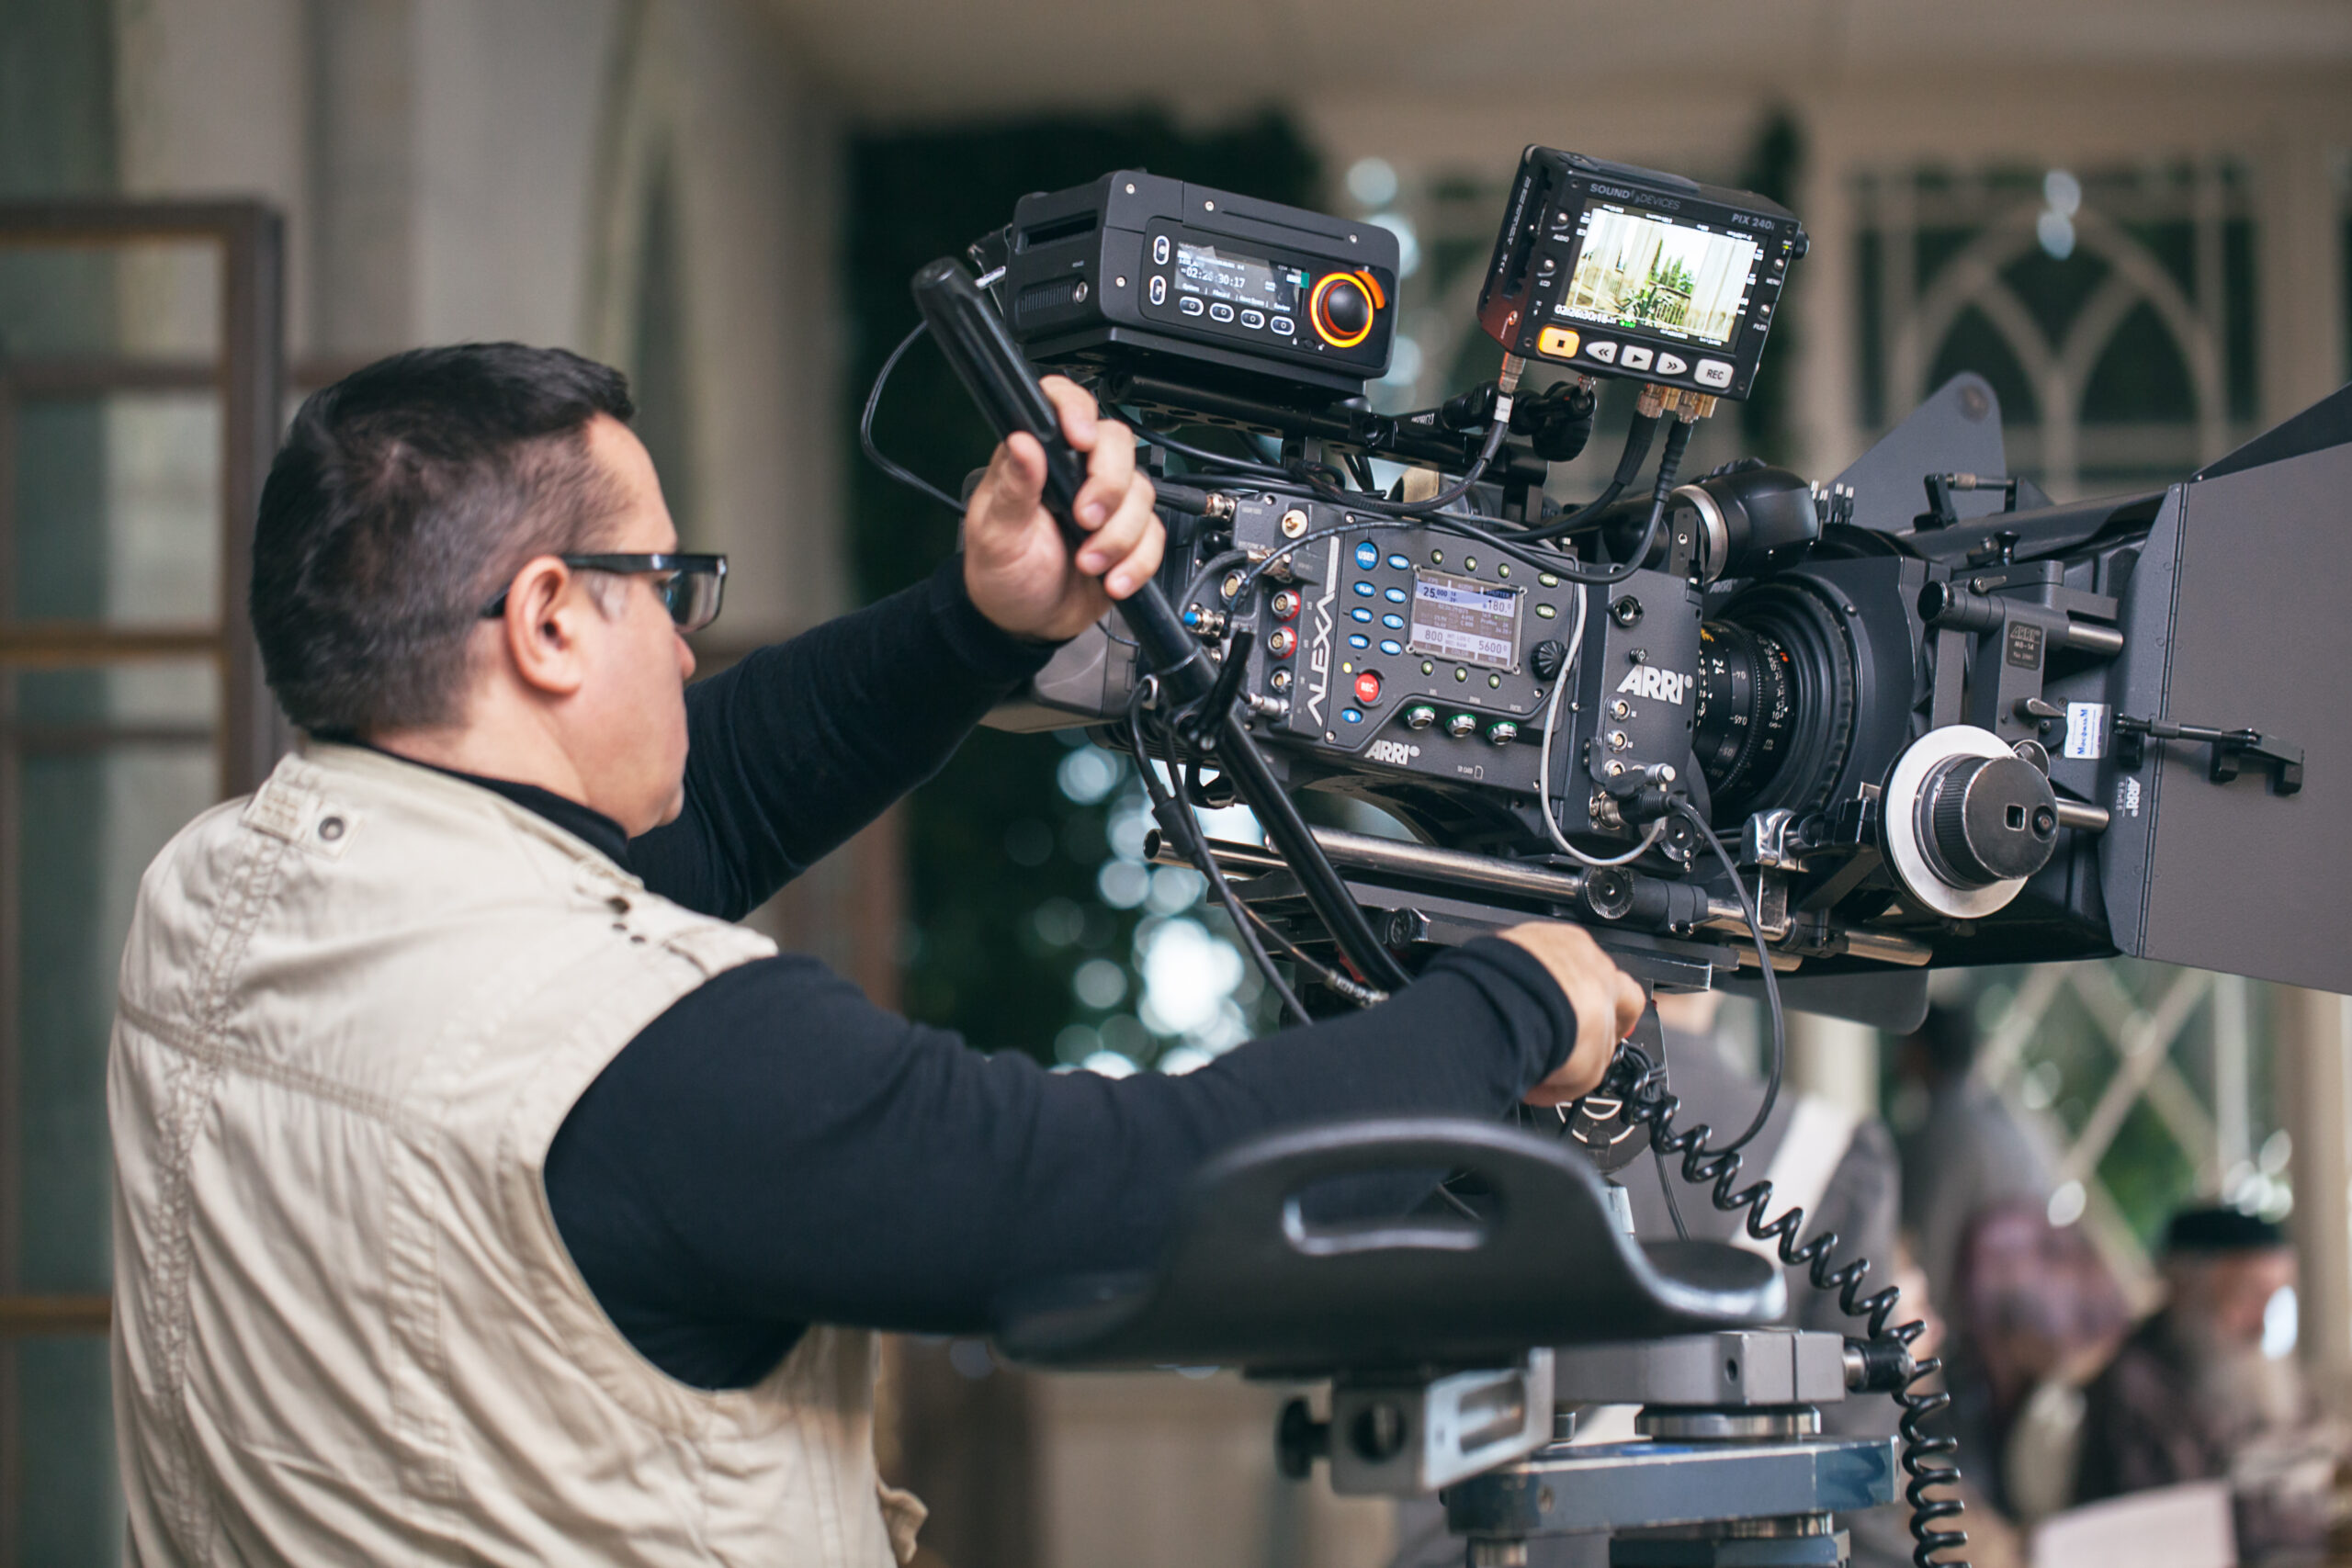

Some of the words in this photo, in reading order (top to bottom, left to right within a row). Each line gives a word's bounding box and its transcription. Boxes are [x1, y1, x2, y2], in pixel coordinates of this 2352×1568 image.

[1589, 183, 1630, 199] SOUND
[1640, 194, 1681, 210] DEVICES
[1731, 213, 1750, 225] PIX
[1752, 218, 1775, 231] 240i
[1706, 368, 1724, 380] REC
[1357, 550, 1375, 562] USER
[1425, 629, 1443, 642] 800
[1478, 640, 1502, 654] 5600
[1307, 592, 1336, 727] ALEXA
[1361, 682, 1374, 693] REC
[1617, 664, 1685, 705] ARRI
[1363, 739, 1410, 765] ARRI
[2125, 776, 2141, 809] ARRI
